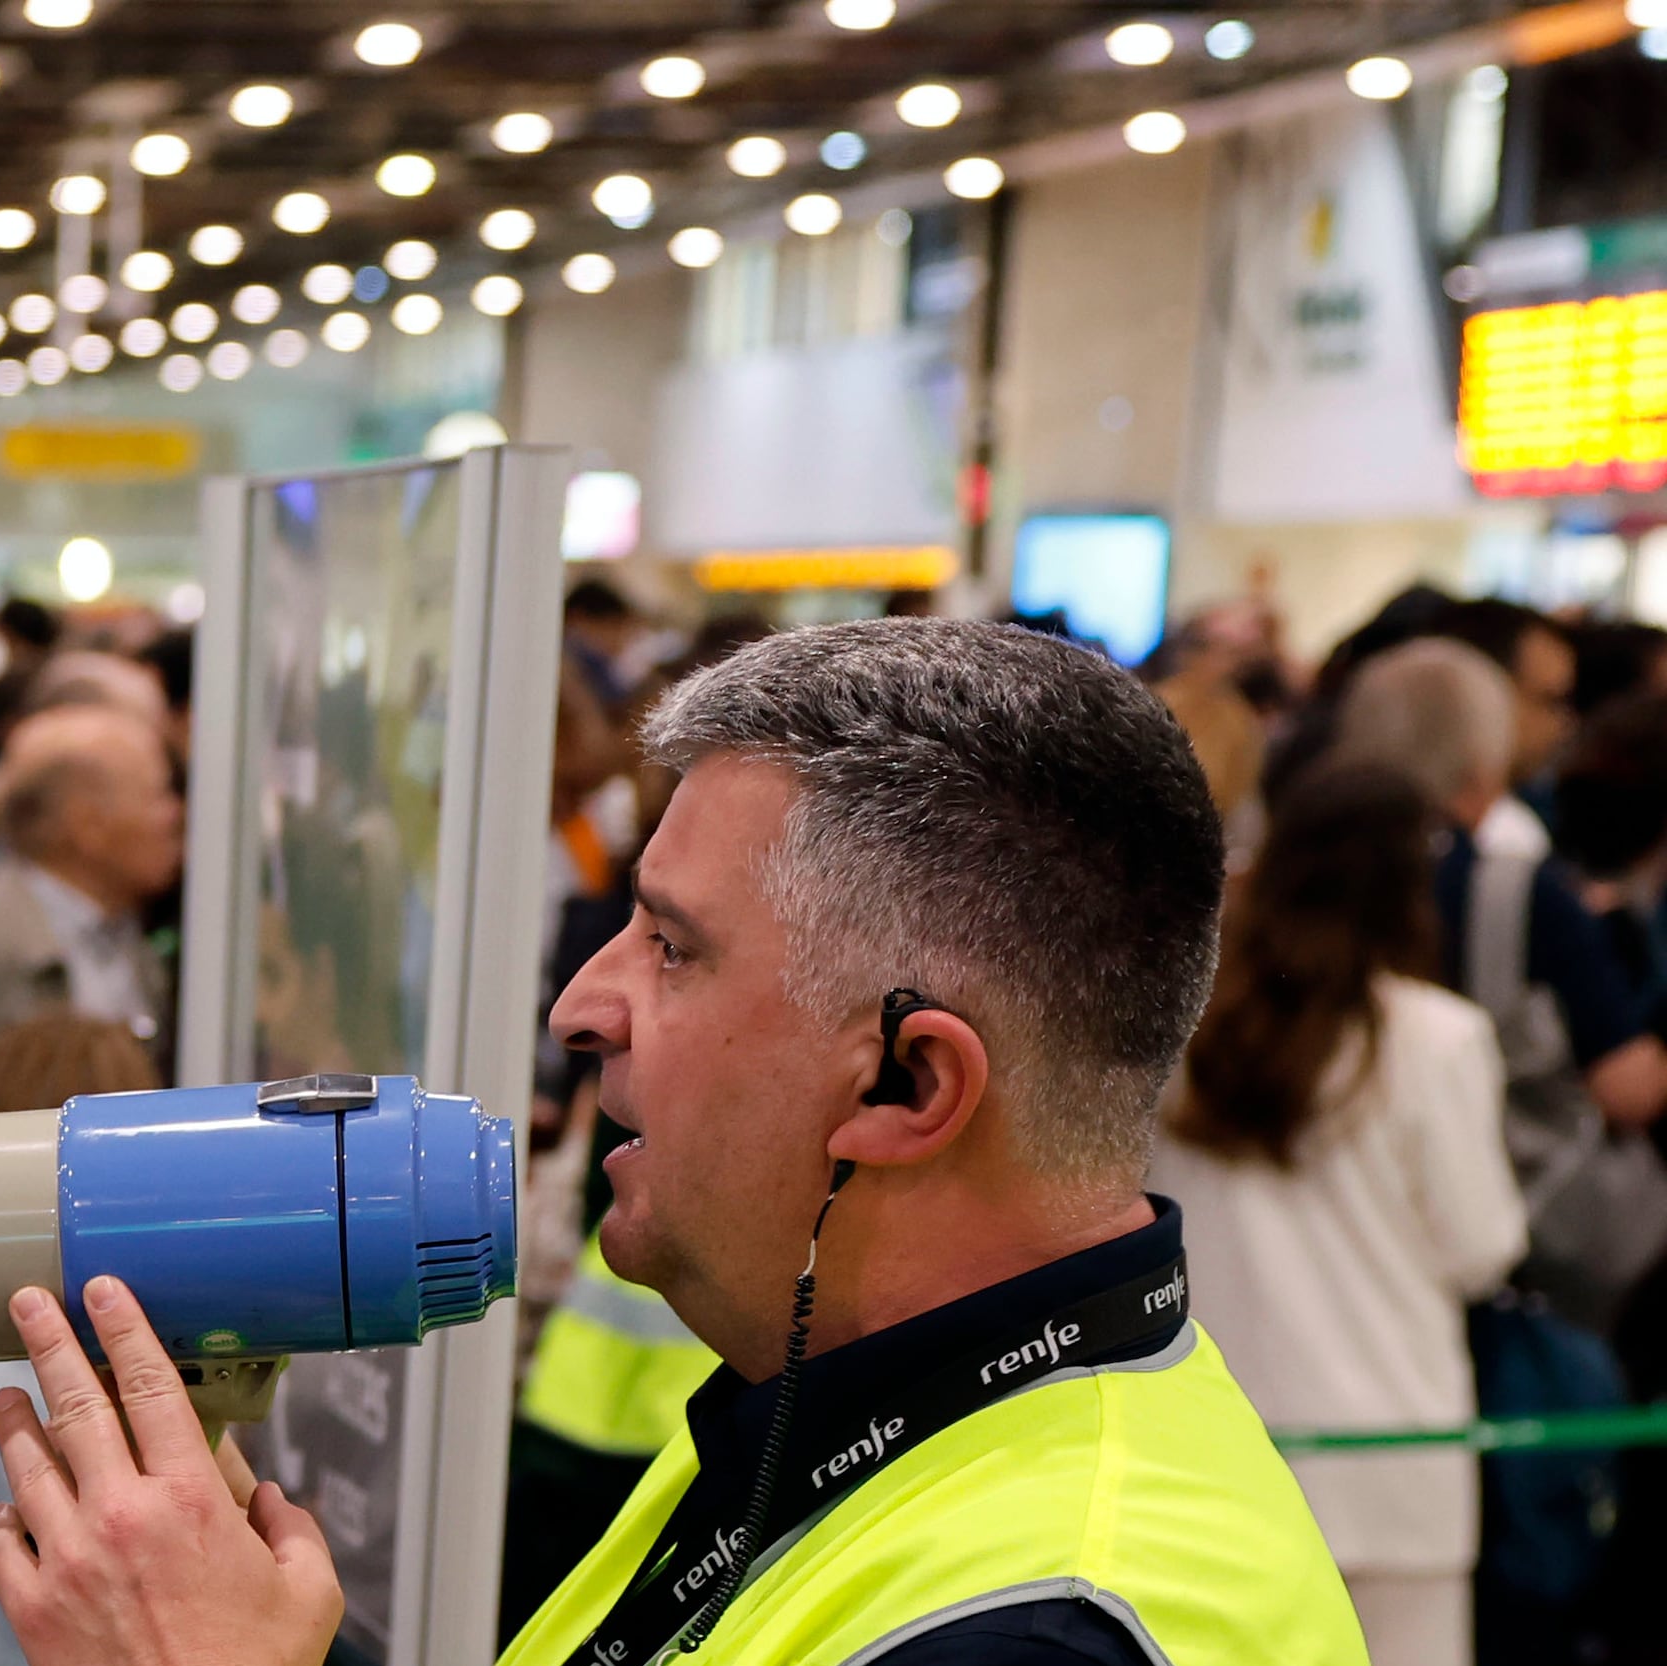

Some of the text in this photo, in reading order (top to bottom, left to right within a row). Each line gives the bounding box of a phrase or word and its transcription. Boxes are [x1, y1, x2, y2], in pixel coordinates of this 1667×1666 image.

[1143, 1264, 1185, 1314] renfe
[980, 1320, 1082, 1385] renfe
[811, 1416, 905, 1489] renfe
